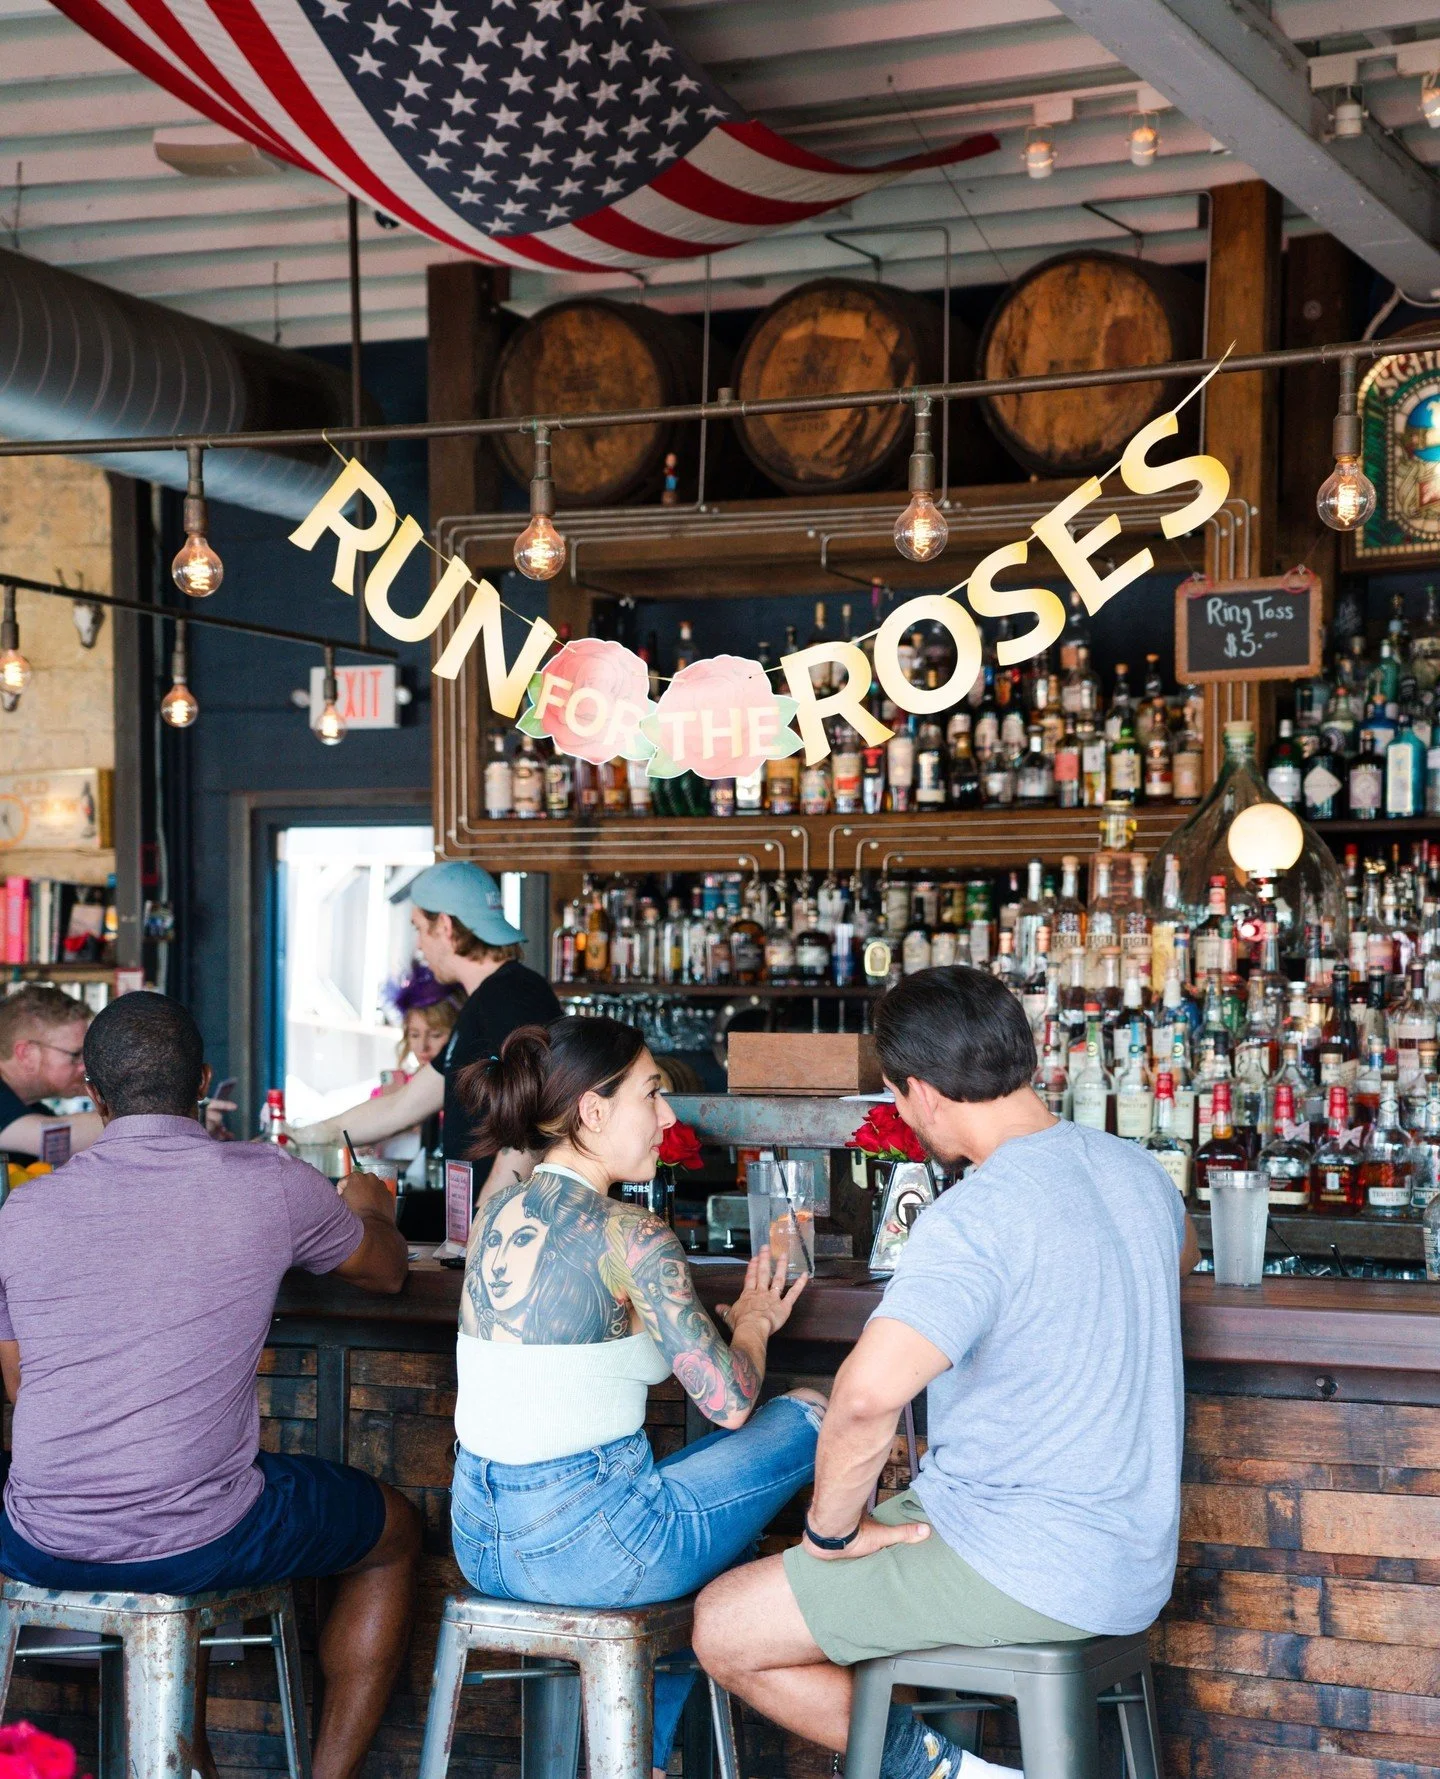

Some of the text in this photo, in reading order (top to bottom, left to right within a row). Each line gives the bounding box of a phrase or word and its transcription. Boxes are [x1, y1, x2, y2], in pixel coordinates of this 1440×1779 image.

[288, 412, 1230, 766] RUN FOR THE ROSES
[1207, 596, 1293, 634] Ring Toss
[333, 670, 383, 718] XIT
